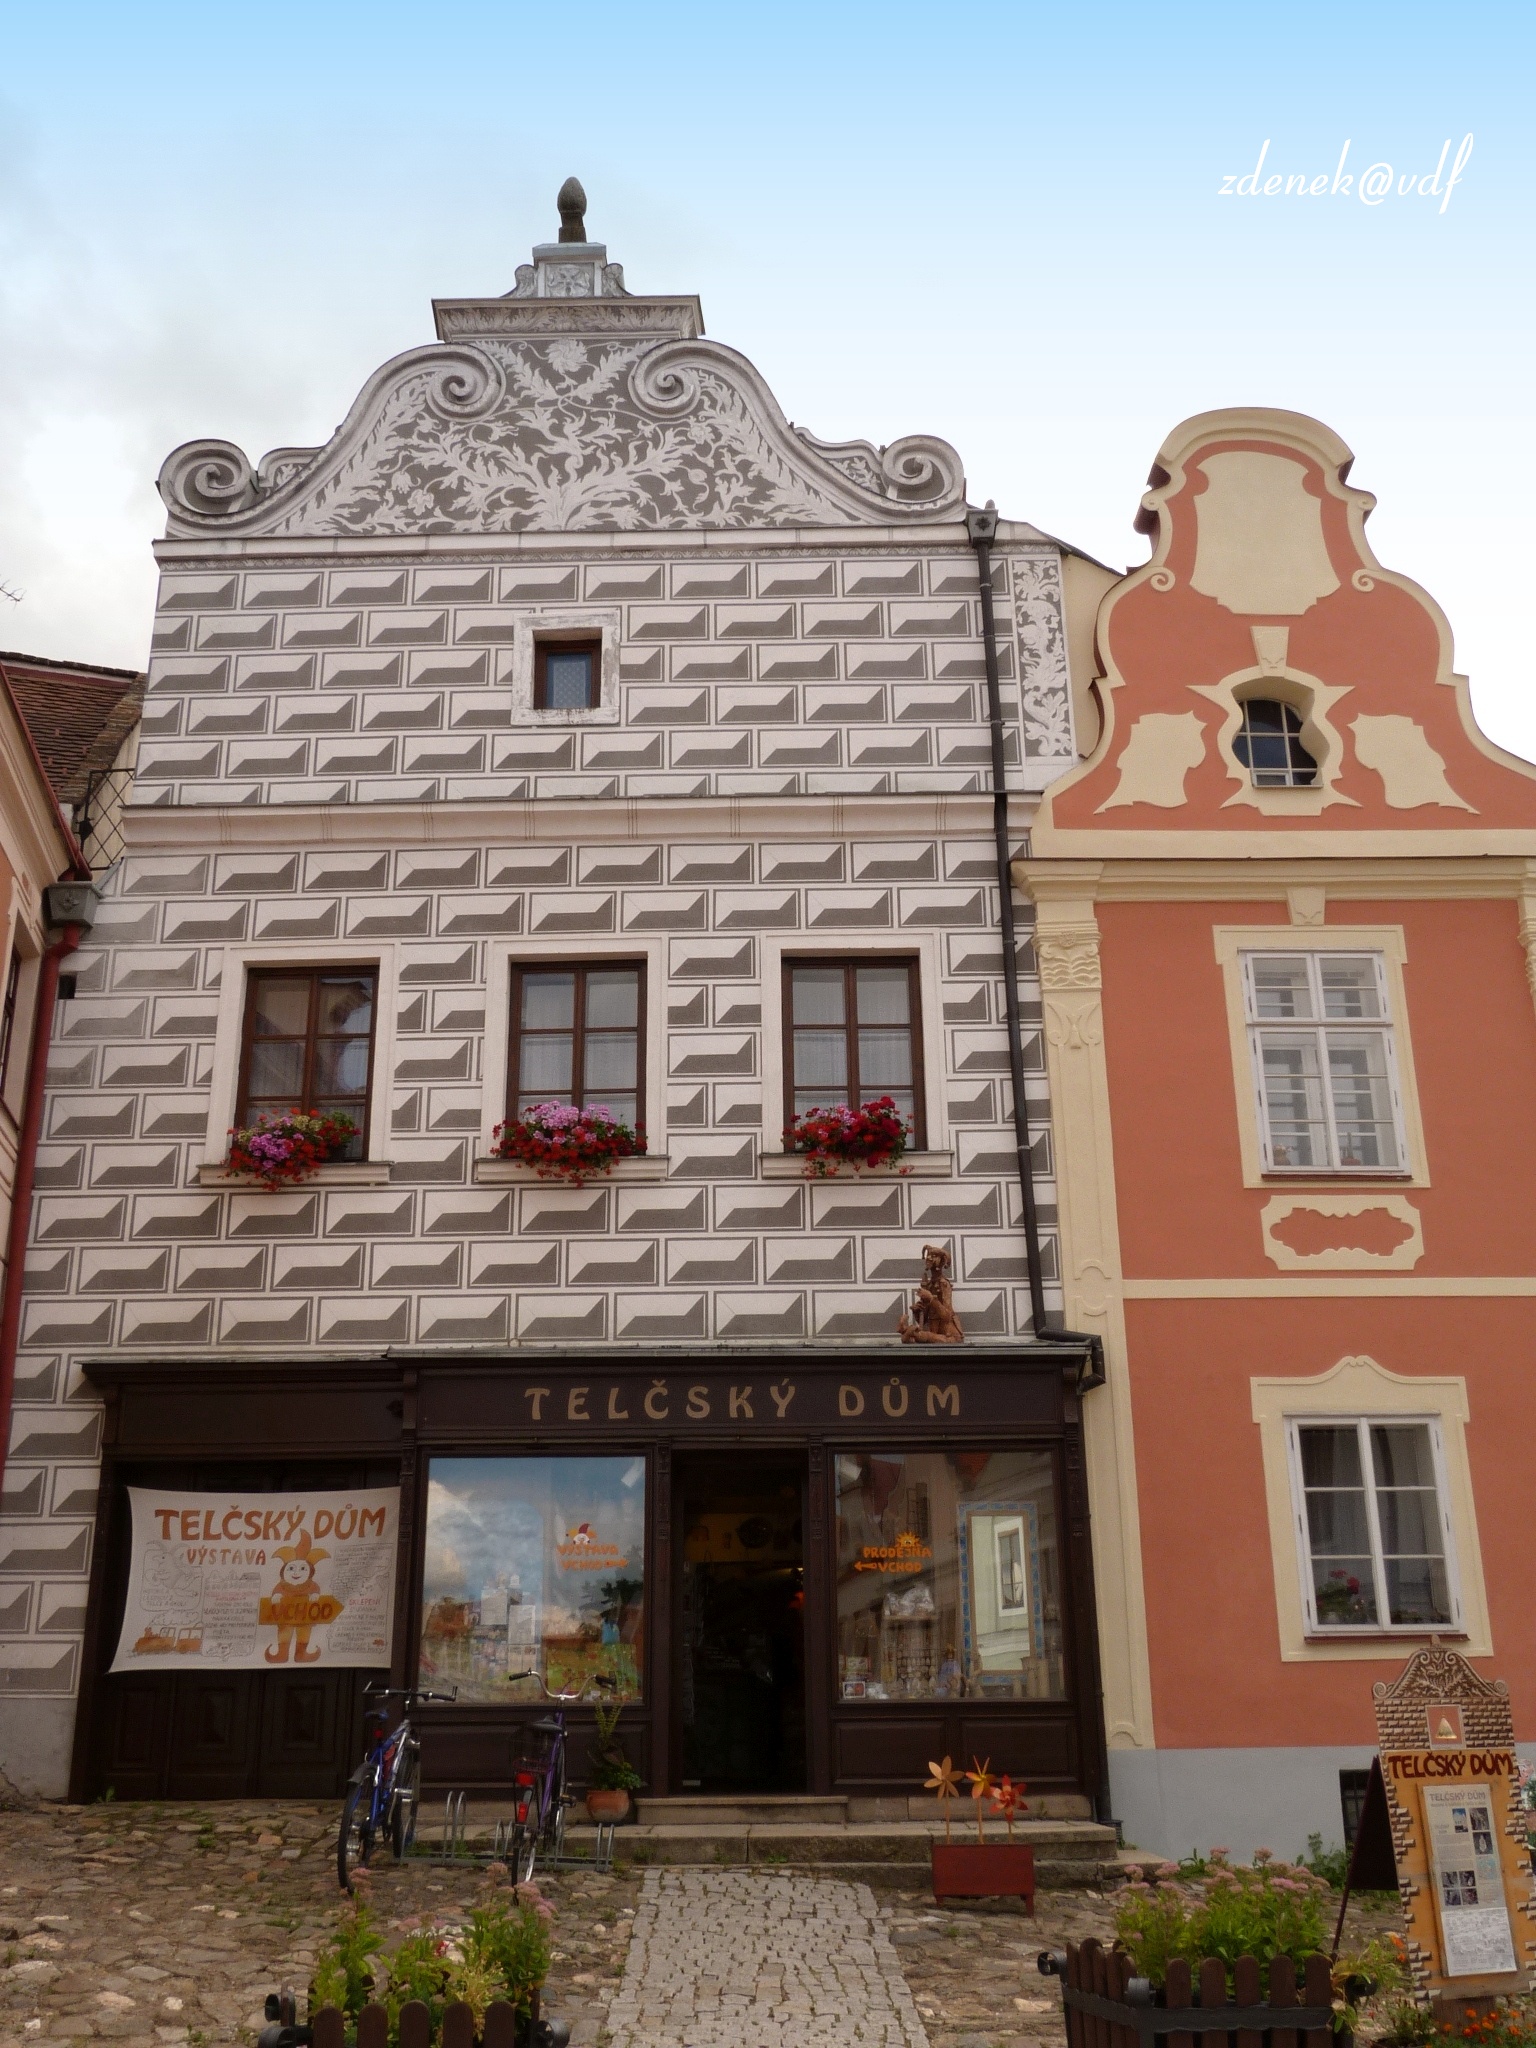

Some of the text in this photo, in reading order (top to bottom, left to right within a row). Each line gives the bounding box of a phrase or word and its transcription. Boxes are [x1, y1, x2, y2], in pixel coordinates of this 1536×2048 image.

[525, 1377, 960, 1420] TELČSKÝ DŮM
[154, 1503, 386, 1541] TELČSKÝ DŮM
[186, 1545, 266, 1566] VÝSTAVA
[271, 1602, 333, 1621] VCHOD
[1388, 1749, 1513, 1779] TELČSKÝ DŮM
